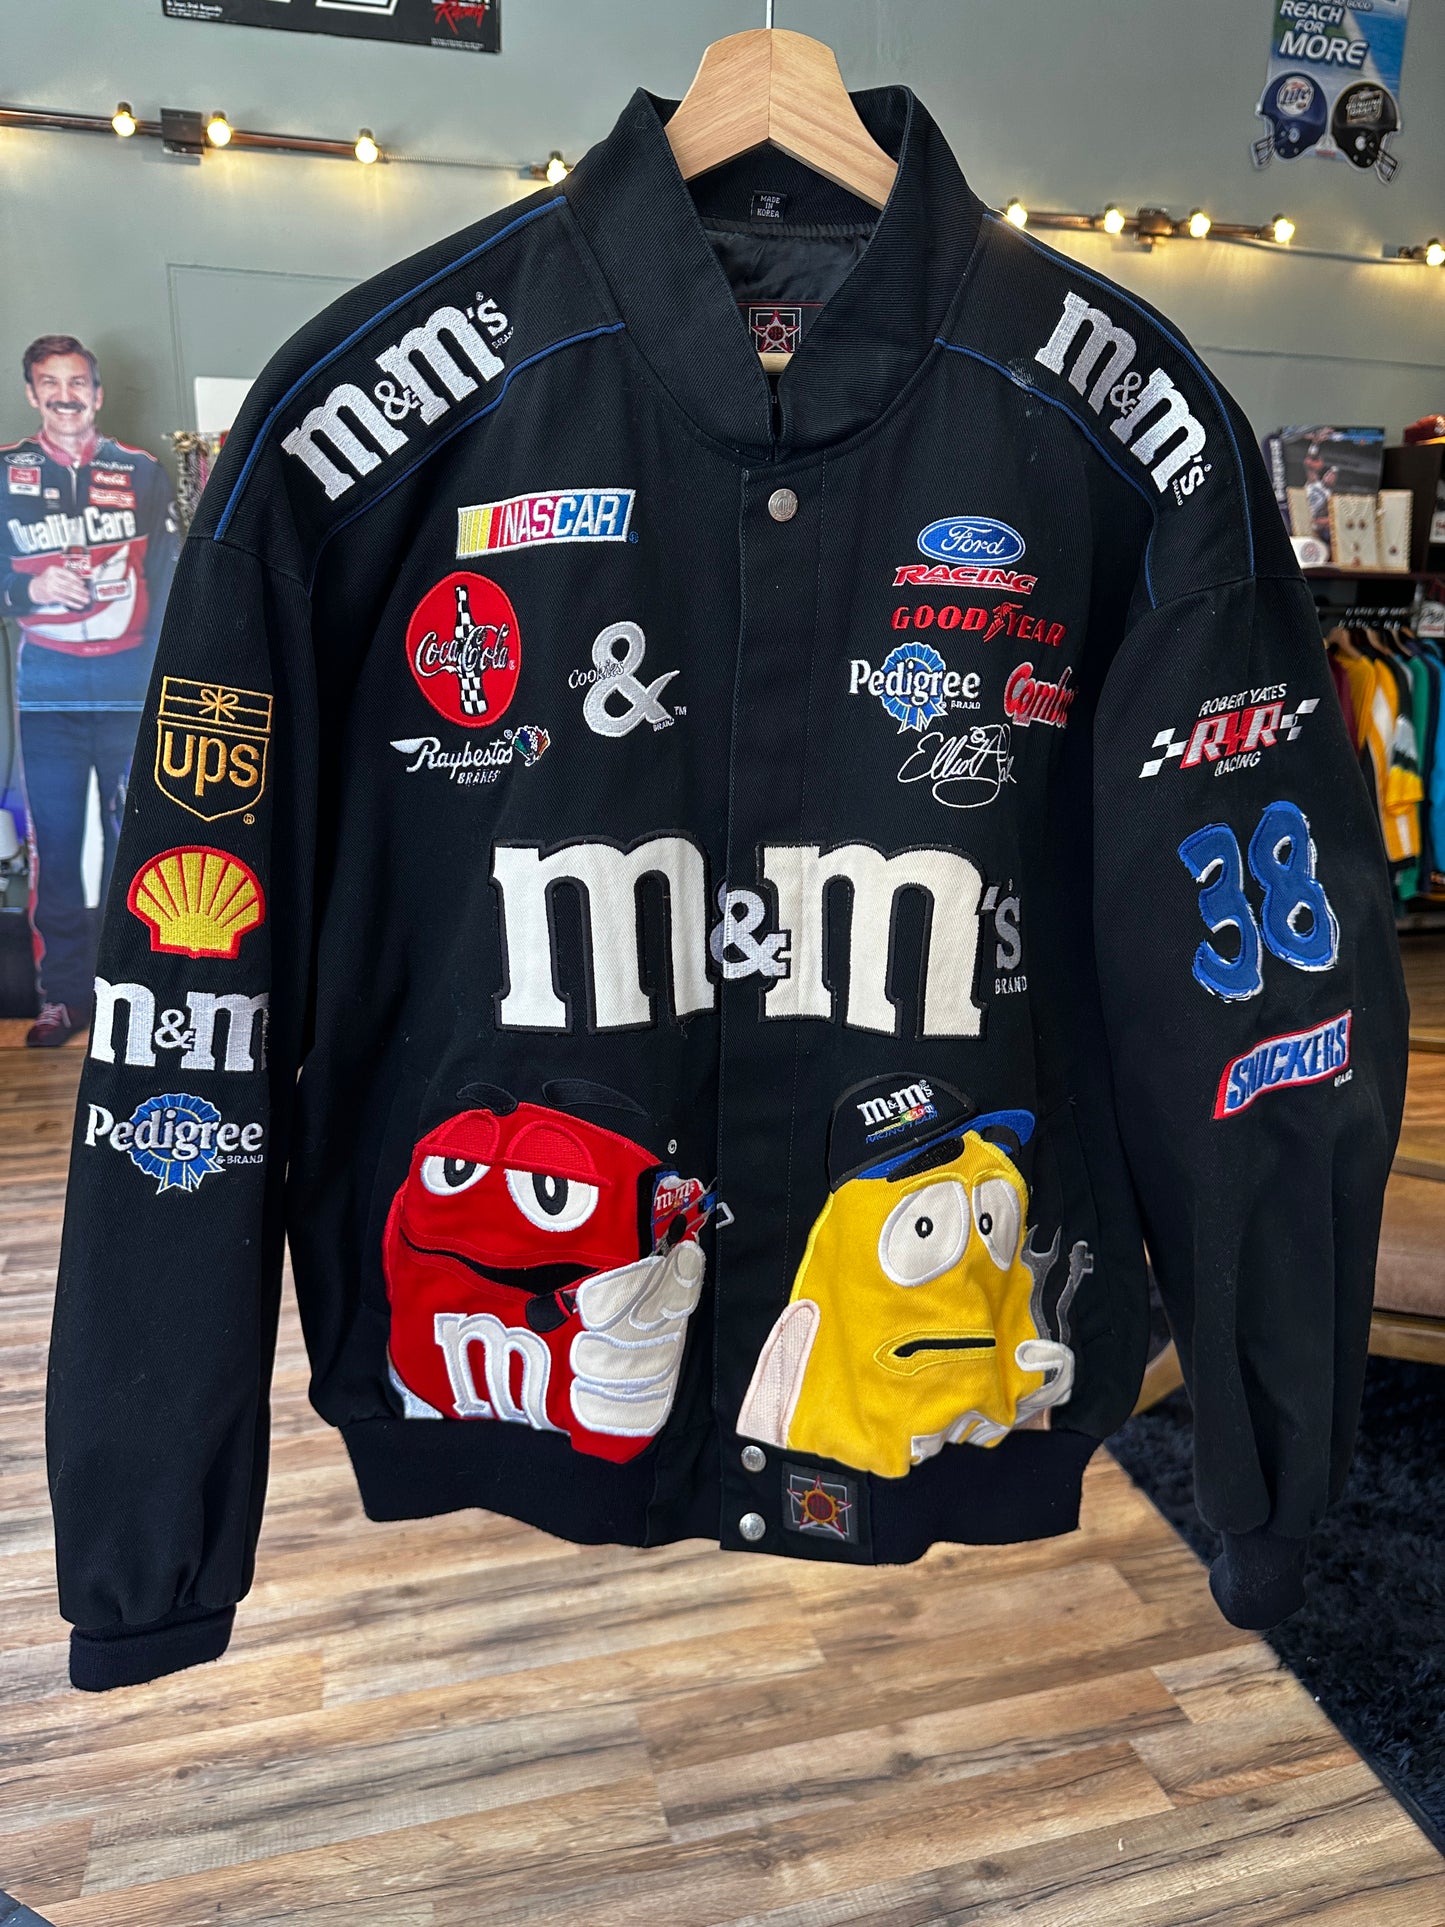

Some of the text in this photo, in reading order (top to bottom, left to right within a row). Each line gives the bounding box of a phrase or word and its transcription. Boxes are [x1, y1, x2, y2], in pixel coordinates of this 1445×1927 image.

[1280, 0, 1343, 24] REACH
[1295, 19, 1325, 34] FOR
[1279, 31, 1368, 65] MORE
[756, 208, 780, 218] KOREA
[760, 195, 781, 204] MADE
[8, 506, 136, 553] Quality Care
[503, 495, 620, 545] NASCAR
[940, 524, 1005, 556] Ford
[892, 565, 1038, 594] RACING
[568, 660, 625, 689] Cookies
[849, 659, 981, 706] Pedigree
[1198, 683, 1287, 717] ROBERT YATES
[389, 736, 513, 780] Raybestos
[1214, 751, 1261, 777] RACING
[456, 768, 501, 787] BRAKES
[1178, 800, 1339, 1003] 38
[994, 975, 1028, 995] BRAND
[1225, 1017, 1347, 1110] SNICKERS
[84, 1103, 264, 1161] Pedigree
[226, 1154, 264, 1164] BRAND
